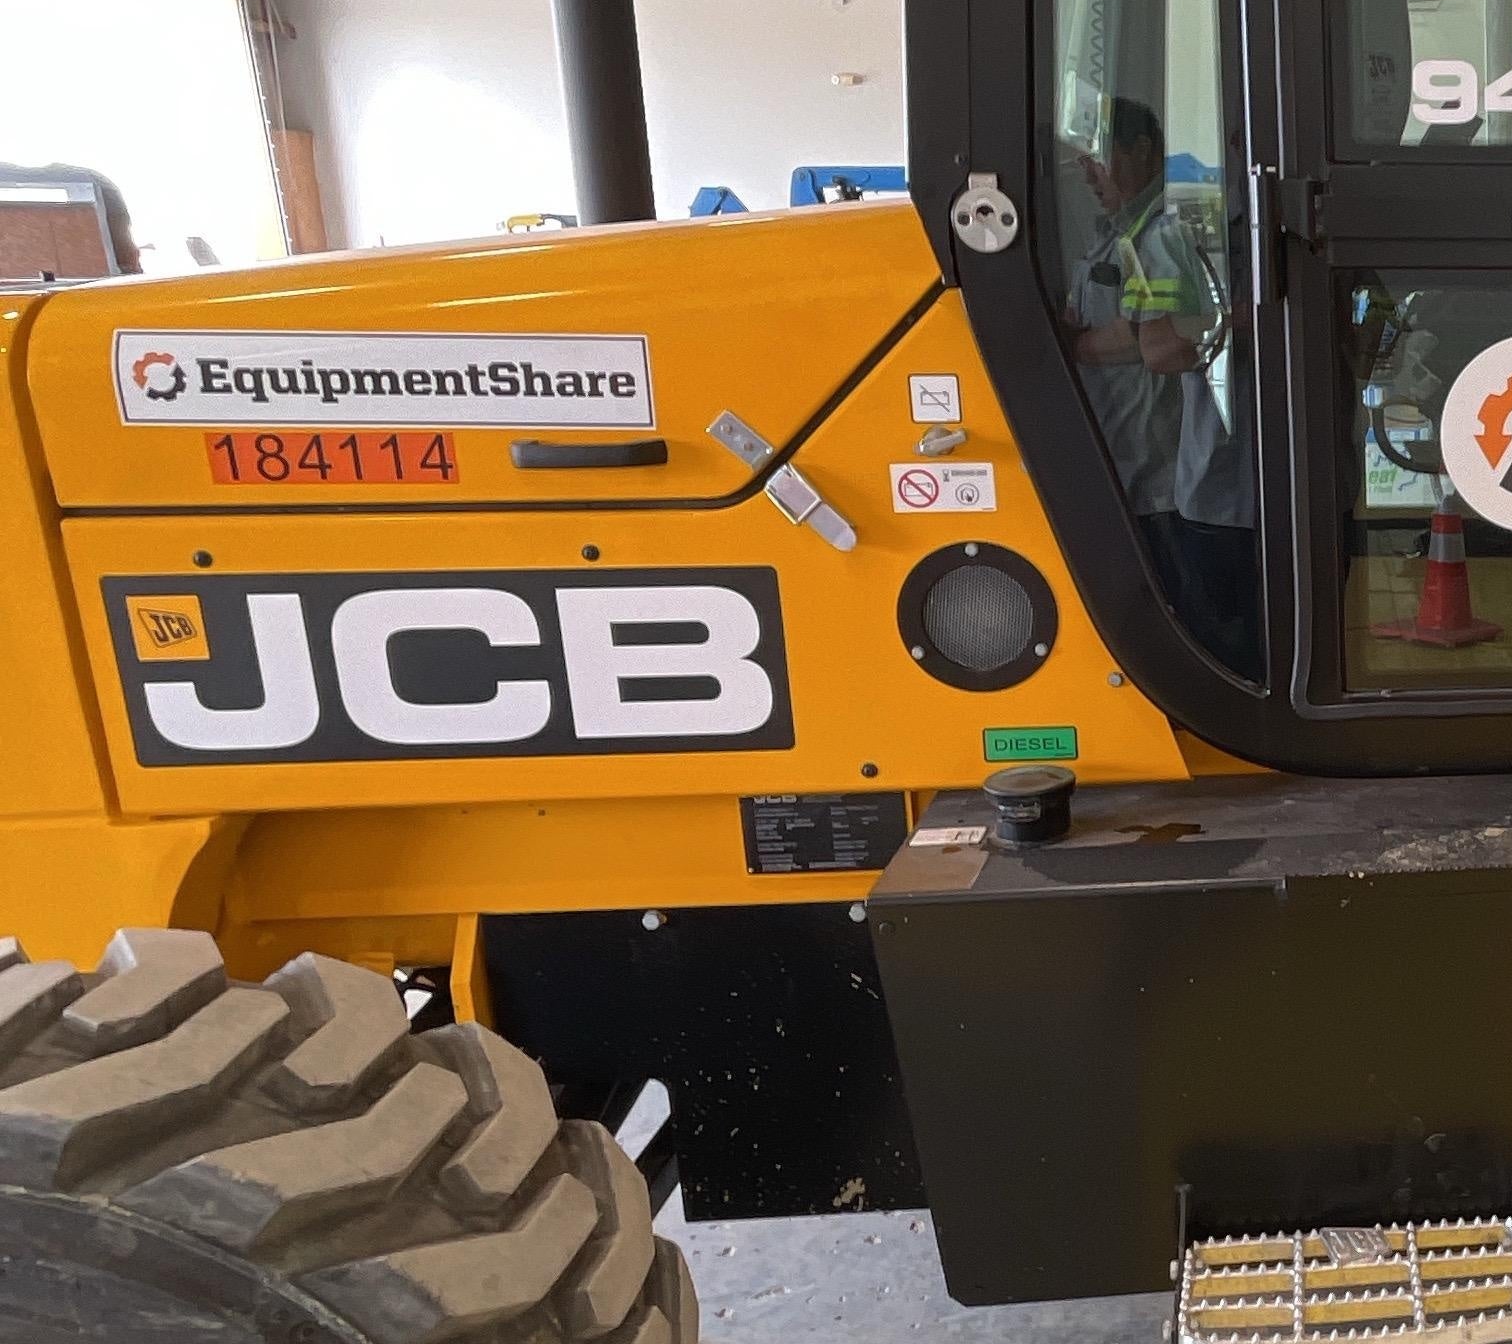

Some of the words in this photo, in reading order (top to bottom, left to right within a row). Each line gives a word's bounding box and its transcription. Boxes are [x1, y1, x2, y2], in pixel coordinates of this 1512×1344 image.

[195, 357, 637, 403] EquipmentShare
[212, 433, 455, 482] 184114
[148, 614, 193, 642] JCB
[143, 585, 774, 750] JCB
[994, 737, 1068, 752] DIESEL
